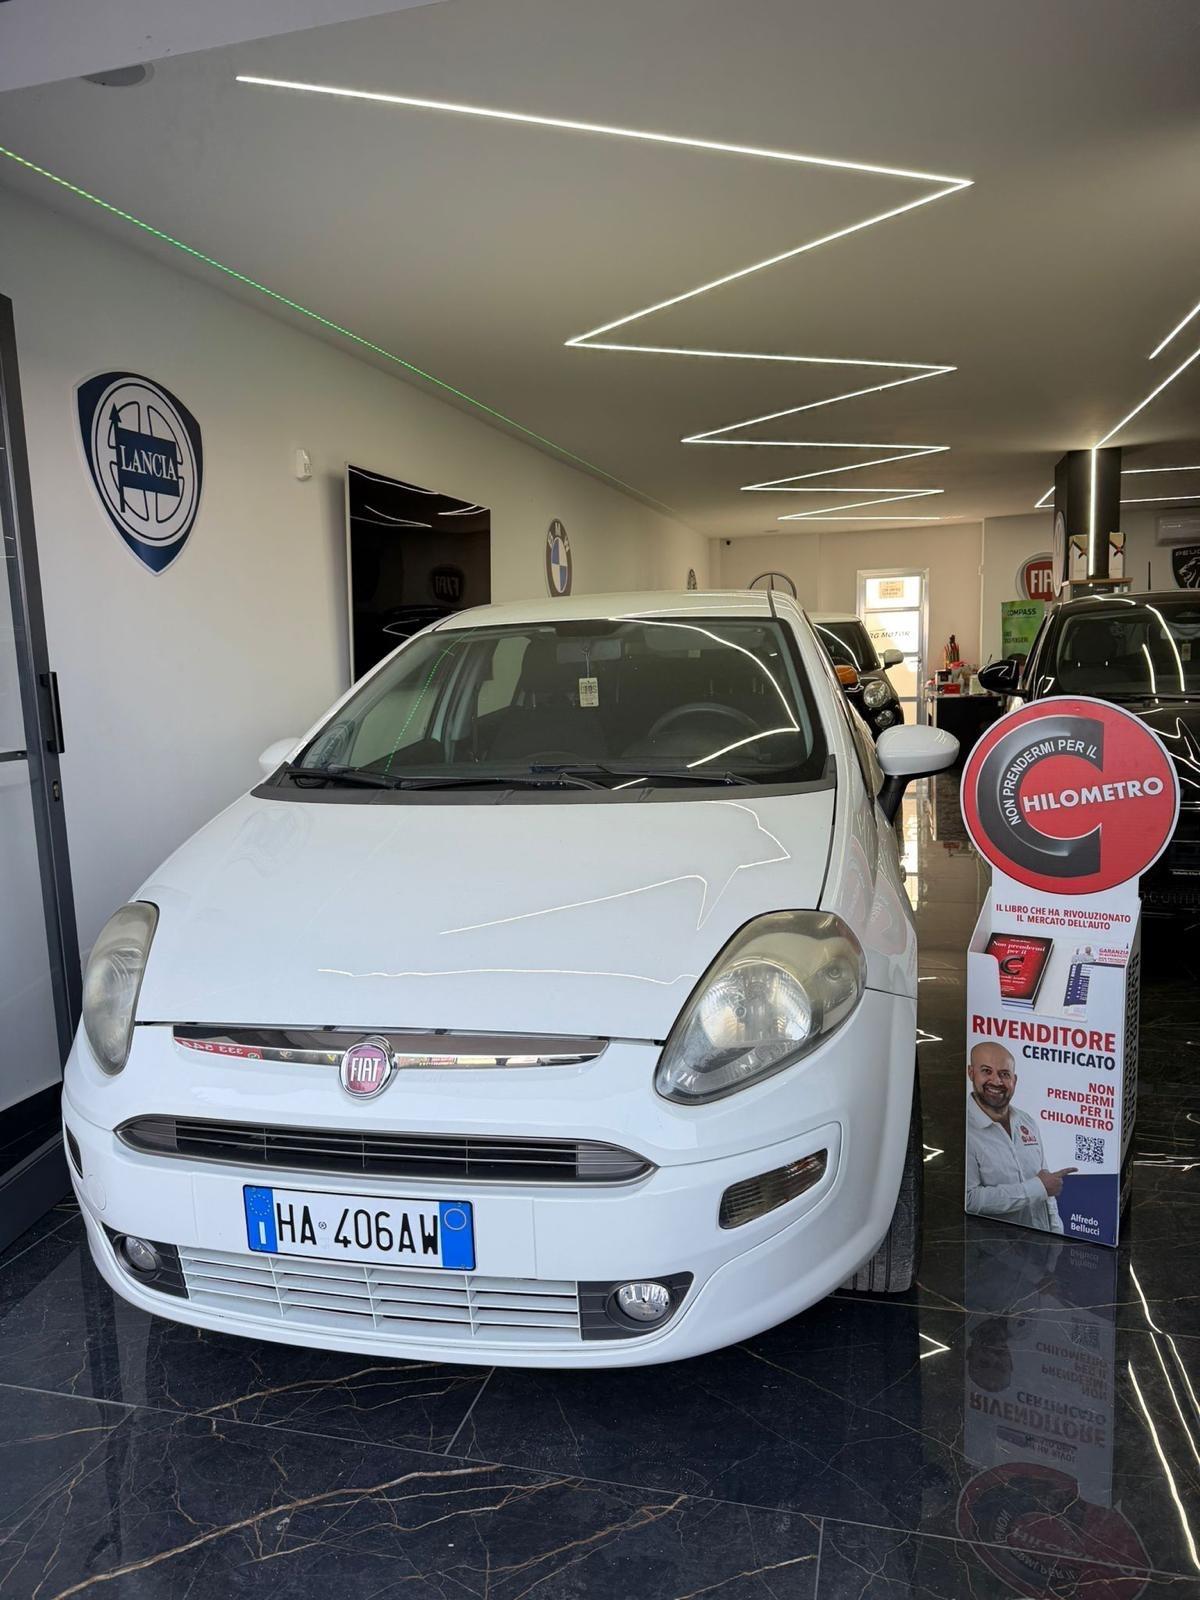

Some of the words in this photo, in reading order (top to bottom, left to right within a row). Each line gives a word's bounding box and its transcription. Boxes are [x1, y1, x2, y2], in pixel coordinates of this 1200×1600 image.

[120, 445, 178, 481] LANCIA
[1030, 570, 1053, 593] FIA
[1058, 739, 1085, 753] PER
[1086, 744, 1098, 759] IL
[1003, 741, 1056, 796] PRENDERMI
[1023, 776, 1164, 813] HILOMETRO
[1003, 800, 1021, 826] NON
[996, 904, 1004, 912] IL
[1005, 904, 1029, 914] LIBRO
[1030, 906, 1046, 916] CHE
[1048, 908, 1060, 917] HA
[1063, 909, 1131, 924] RIVOLUZIONATO
[1016, 914, 1024, 922] IL
[1027, 915, 1066, 926] MERCATO
[1067, 919, 1111, 931] DELL'AUTO
[972, 1014, 1116, 1053] RIVENDITORE
[1022, 1045, 1116, 1071] CERTIFICATO
[350, 1056, 382, 1082] FIAT
[1047, 1088, 1115, 1108] PRENDERMI
[1089, 1083, 1115, 1097] NON
[1040, 1110, 1114, 1132] CHILOMETRO
[1080, 1105, 1101, 1118] PER
[1104, 1107, 1115, 1120] IL
[1070, 1213, 1099, 1227] Alfredo
[1070, 1223, 1100, 1236] Bellucci
